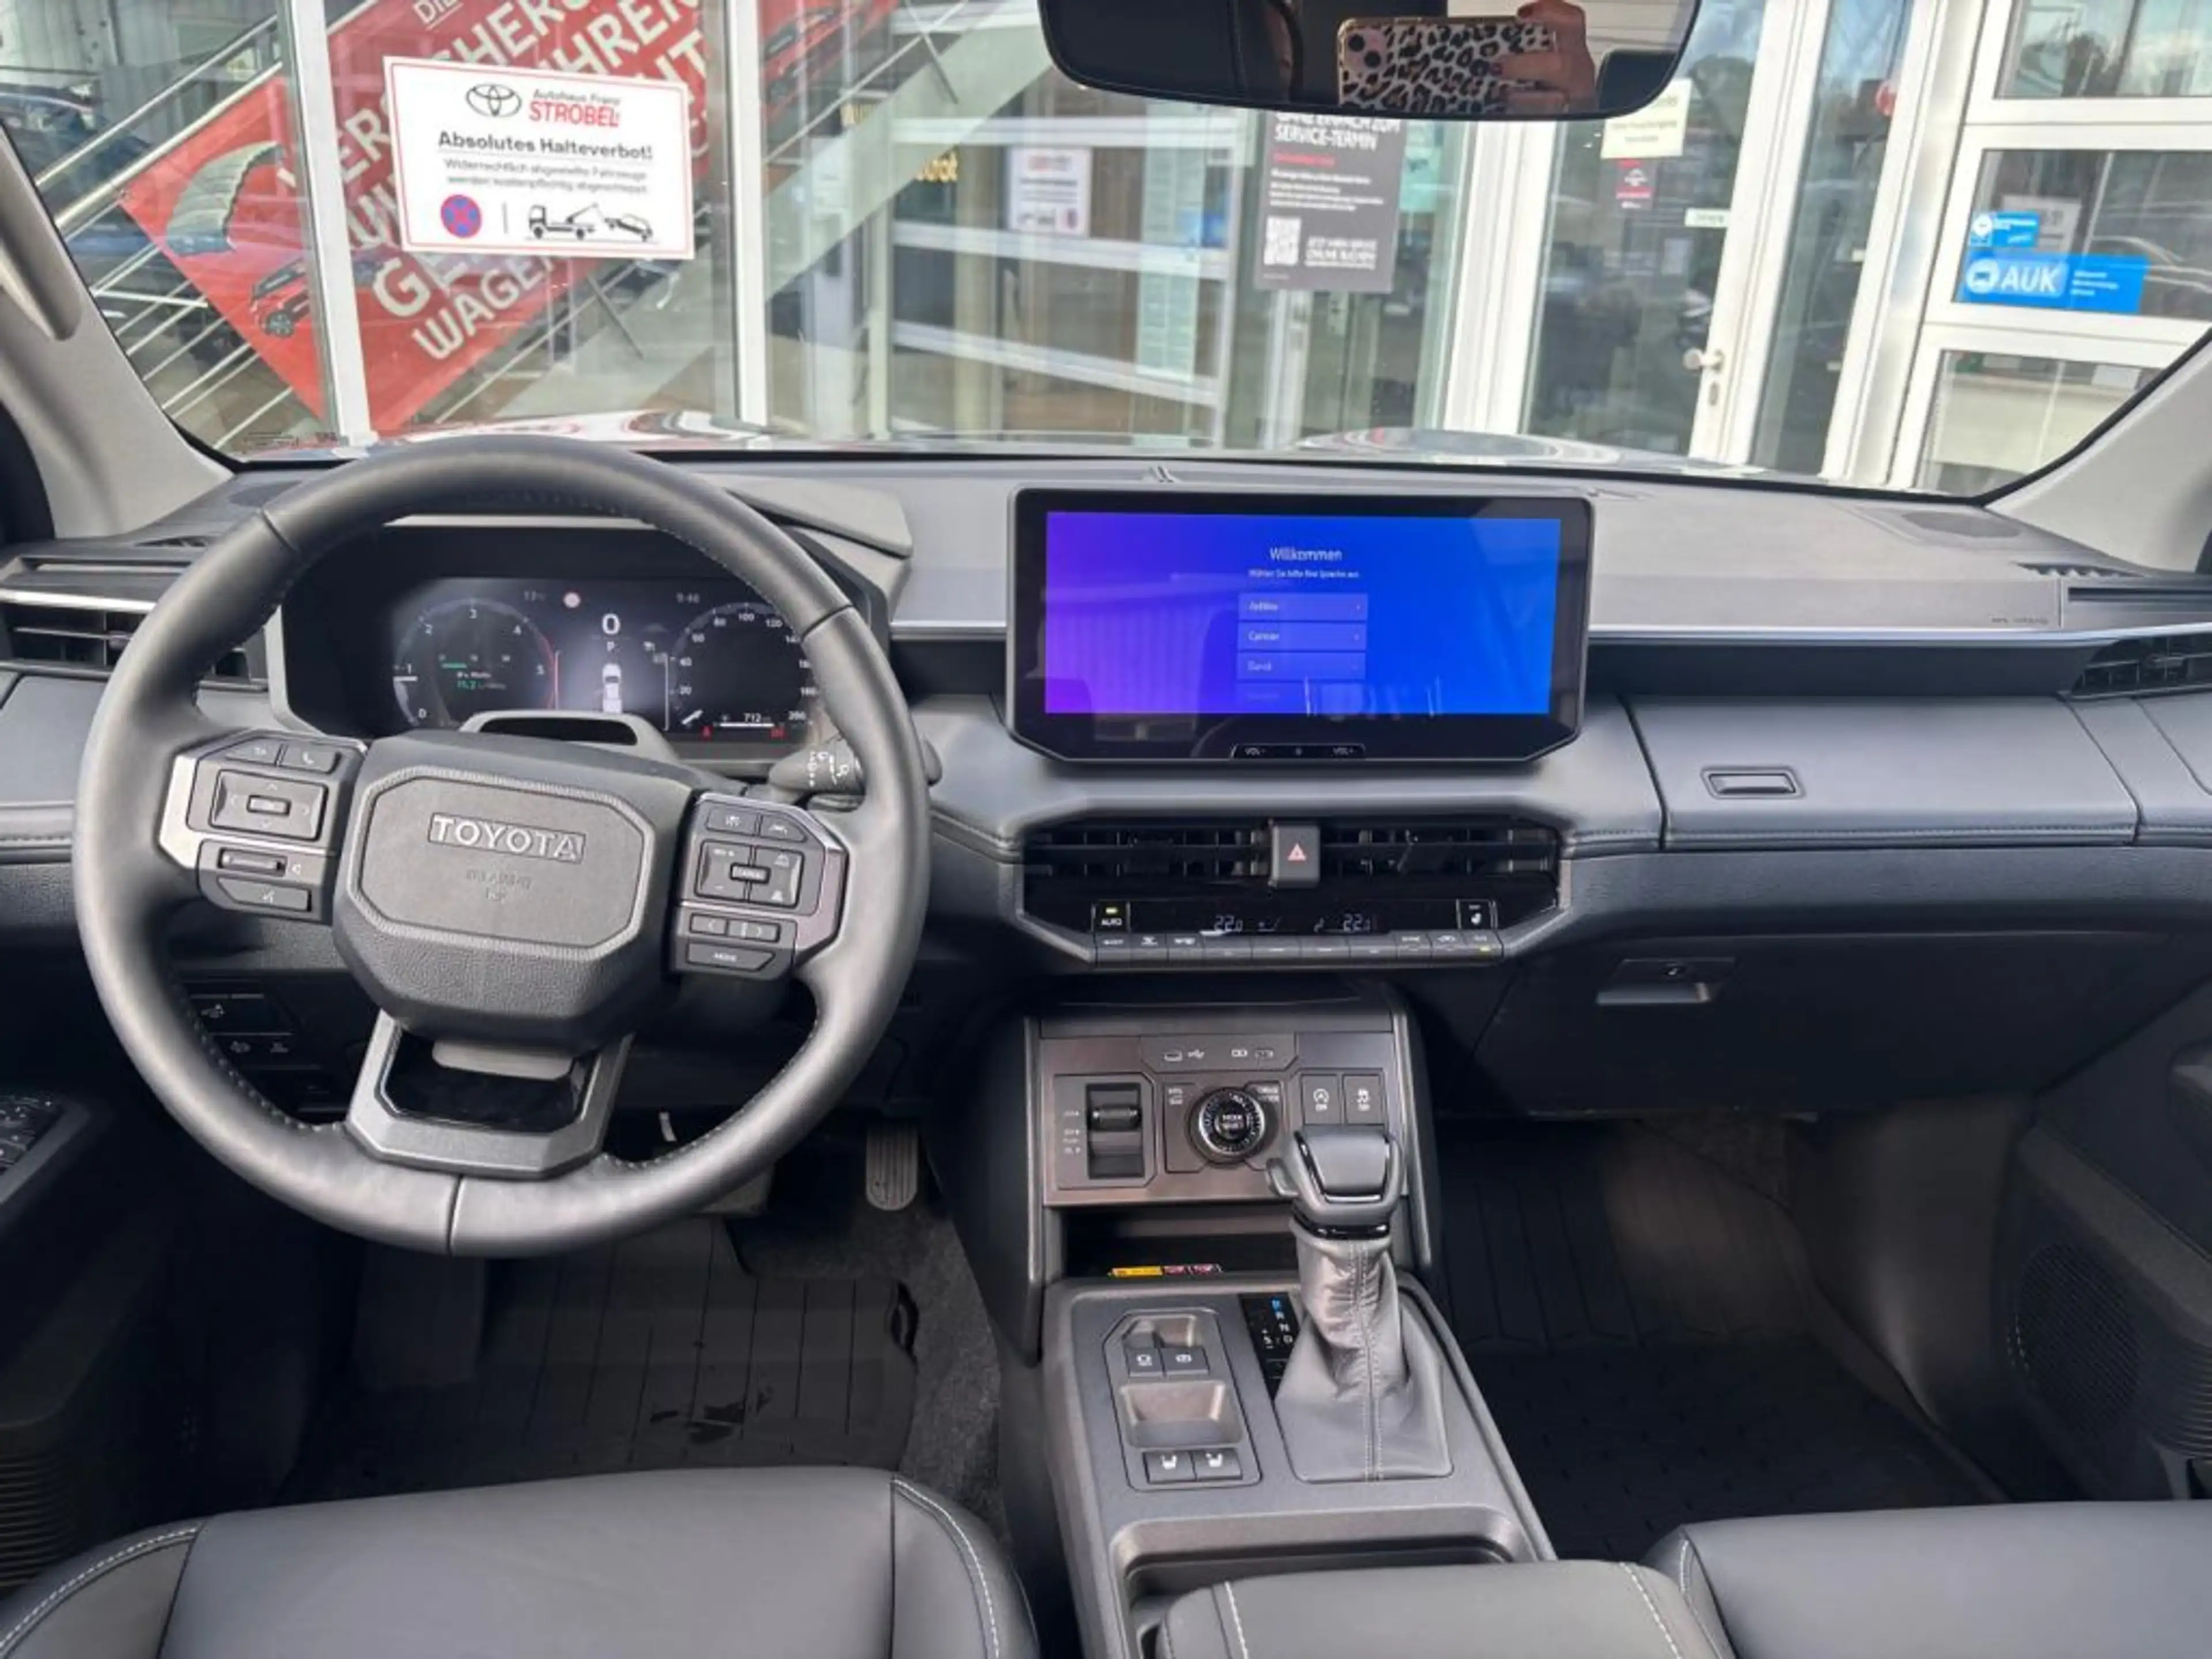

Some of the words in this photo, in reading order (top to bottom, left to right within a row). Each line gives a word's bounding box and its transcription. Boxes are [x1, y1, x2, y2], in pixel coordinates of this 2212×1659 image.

[438, 130, 536, 153] Absolutes
[540, 137, 653, 161] Halteverbot!
[2002, 263, 2059, 294] AUK
[410, 256, 554, 361] WAGE
[1270, 547, 1343, 562] Willkommen
[602, 613, 620, 635] 0
[738, 613, 755, 622] 100
[765, 618, 783, 628] 120
[432, 815, 577, 860] TOYOTA
